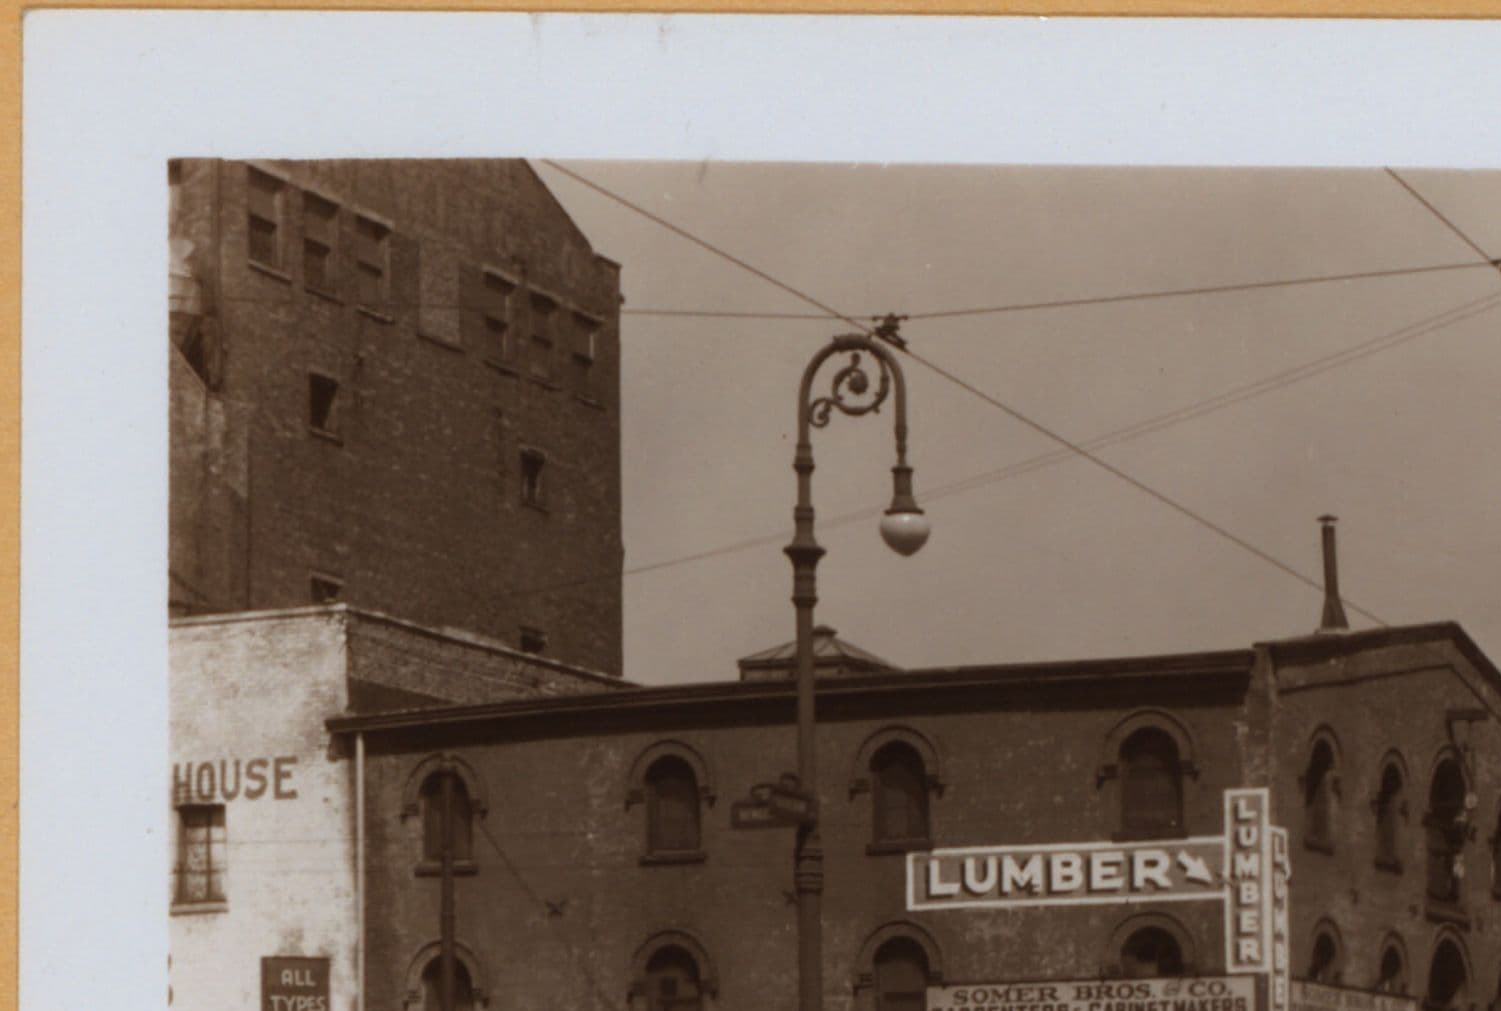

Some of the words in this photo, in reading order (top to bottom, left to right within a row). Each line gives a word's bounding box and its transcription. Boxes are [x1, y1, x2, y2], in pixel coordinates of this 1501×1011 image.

[173, 756, 299, 801] HOUSE
[930, 849, 1172, 897] LUMBER
[1236, 797, 1262, 965] LUMBER
[281, 969, 318, 986] ALL
[952, 985, 1059, 1006] SOMER
[1072, 981, 1157, 1002] BROS.
[1188, 978, 1233, 998] CO.
